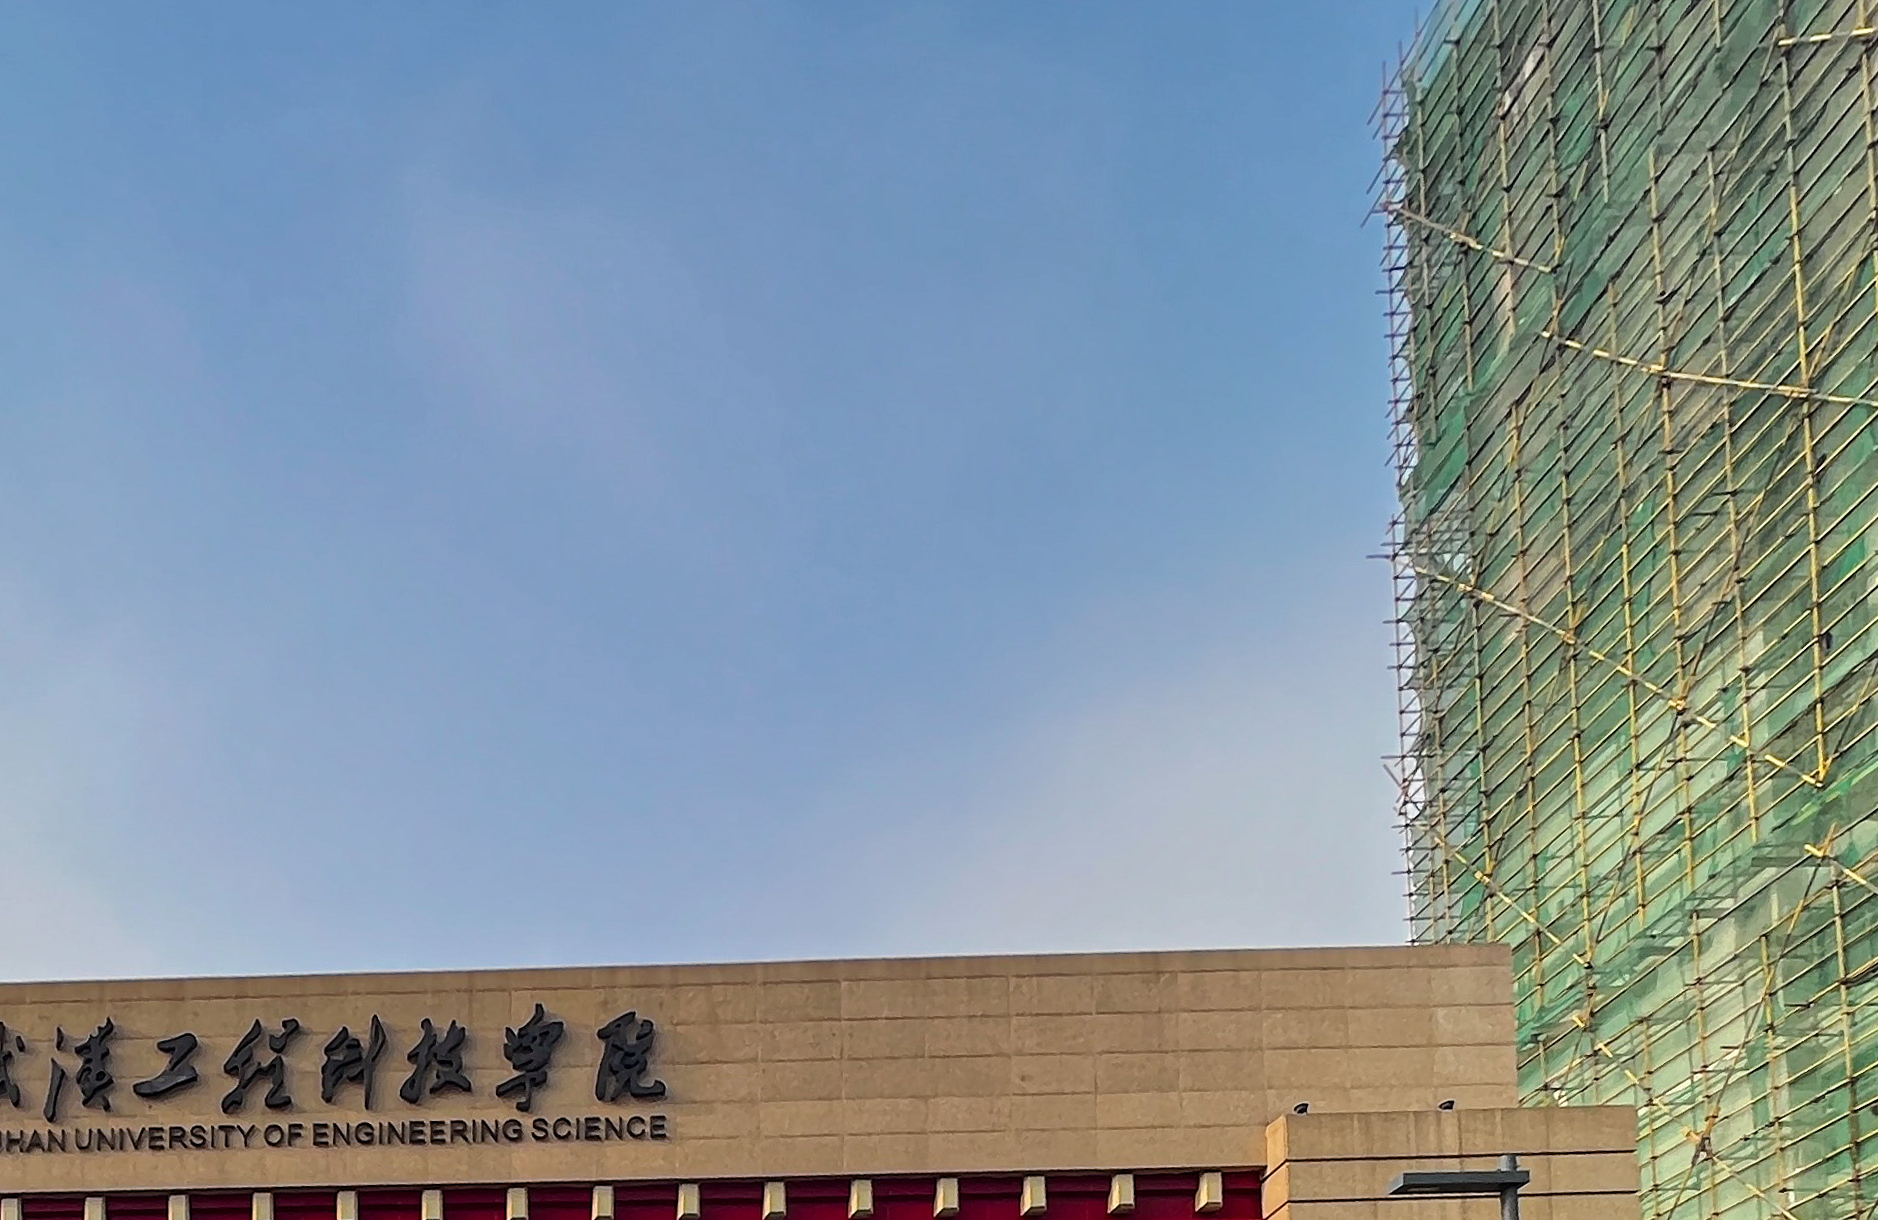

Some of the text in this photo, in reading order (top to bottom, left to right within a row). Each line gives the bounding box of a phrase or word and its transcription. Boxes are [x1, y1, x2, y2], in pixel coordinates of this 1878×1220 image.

[74, 1124, 254, 1150] UNIVERSITY
[264, 1123, 304, 1148] OF
[312, 1119, 522, 1147] ENGINEERING
[531, 1115, 667, 1142] SCIENCE
